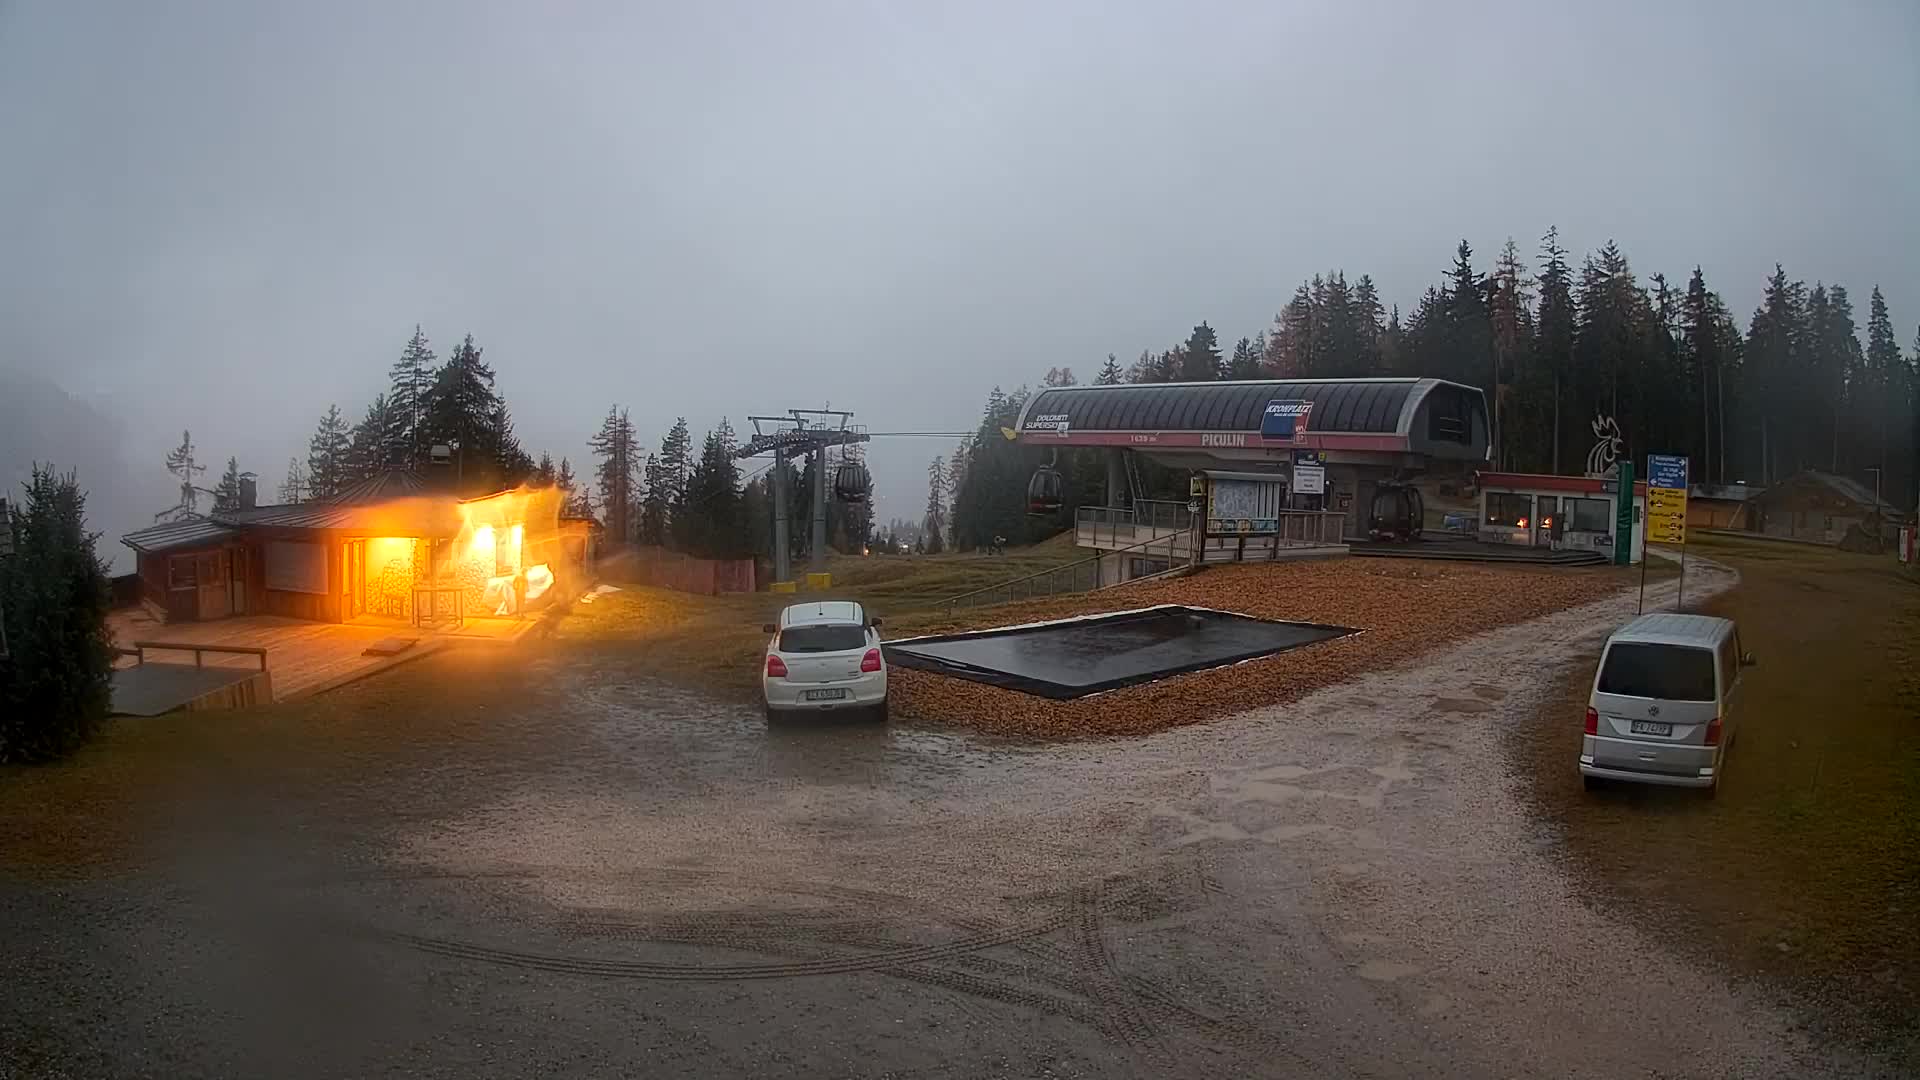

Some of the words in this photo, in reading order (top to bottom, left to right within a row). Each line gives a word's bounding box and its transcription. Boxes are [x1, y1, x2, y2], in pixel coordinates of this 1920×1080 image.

[1266, 404, 1312, 413] KRONPLATZ
[1036, 414, 1068, 422] DOLOMITI
[1025, 421, 1058, 429] SUPERSKI
[1201, 433, 1245, 447] PICULIN
